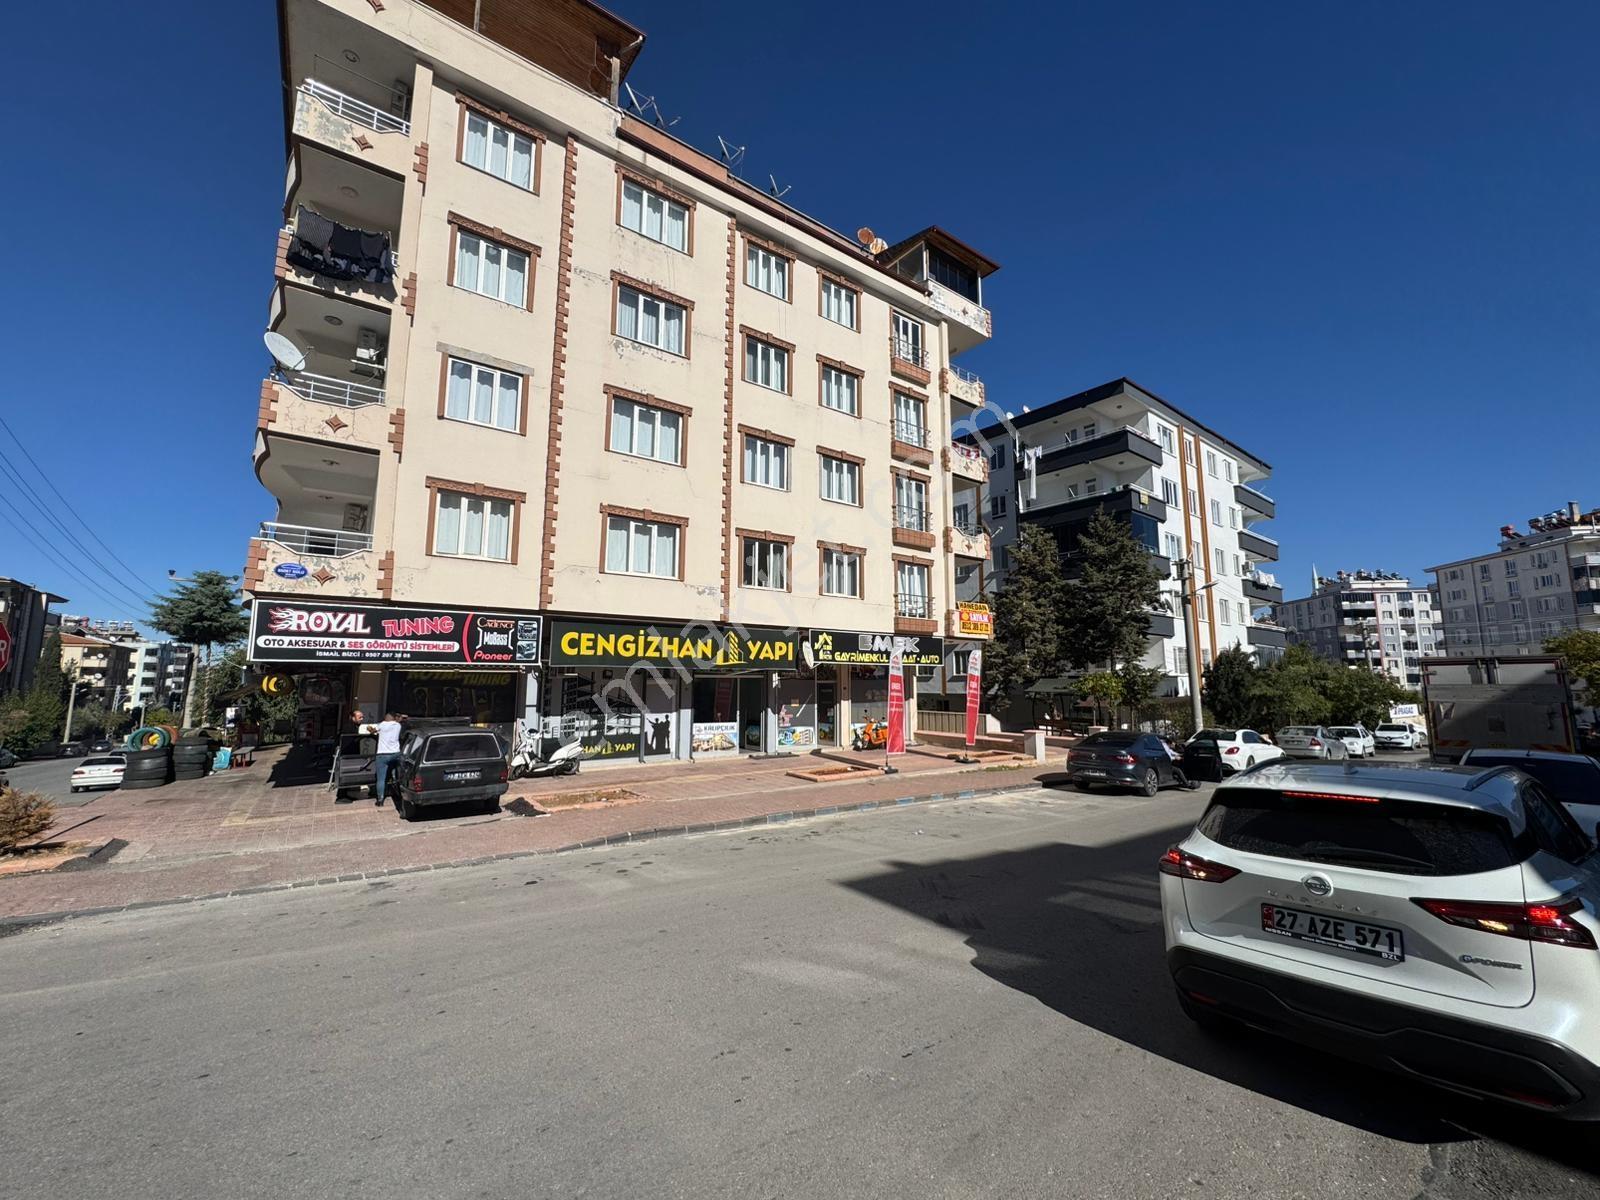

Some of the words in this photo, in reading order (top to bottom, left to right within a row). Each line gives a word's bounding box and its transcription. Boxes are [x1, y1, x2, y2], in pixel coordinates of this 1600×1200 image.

[289, 610, 371, 634] ROYAL
[381, 615, 455, 638] TUNING
[263, 638, 285, 647] OTO
[287, 638, 338, 648] AKSESUAR
[339, 640, 346, 648] &
[347, 640, 365, 649] SES
[366, 639, 408, 650] GÖRÜNTÜ
[409, 641, 455, 651] SİSTEMLERİ
[560, 629, 713, 658] CENGİZHAN
[747, 640, 793, 661] YAPI
[858, 634, 920, 653] EMEK
[834, 650, 889, 663] GAYRİMENKUL
[614, 743, 635, 752] YAPI
[1274, 910, 1298, 930] 27
[1307, 916, 1346, 942] AZE
[1355, 925, 1395, 953] 571
